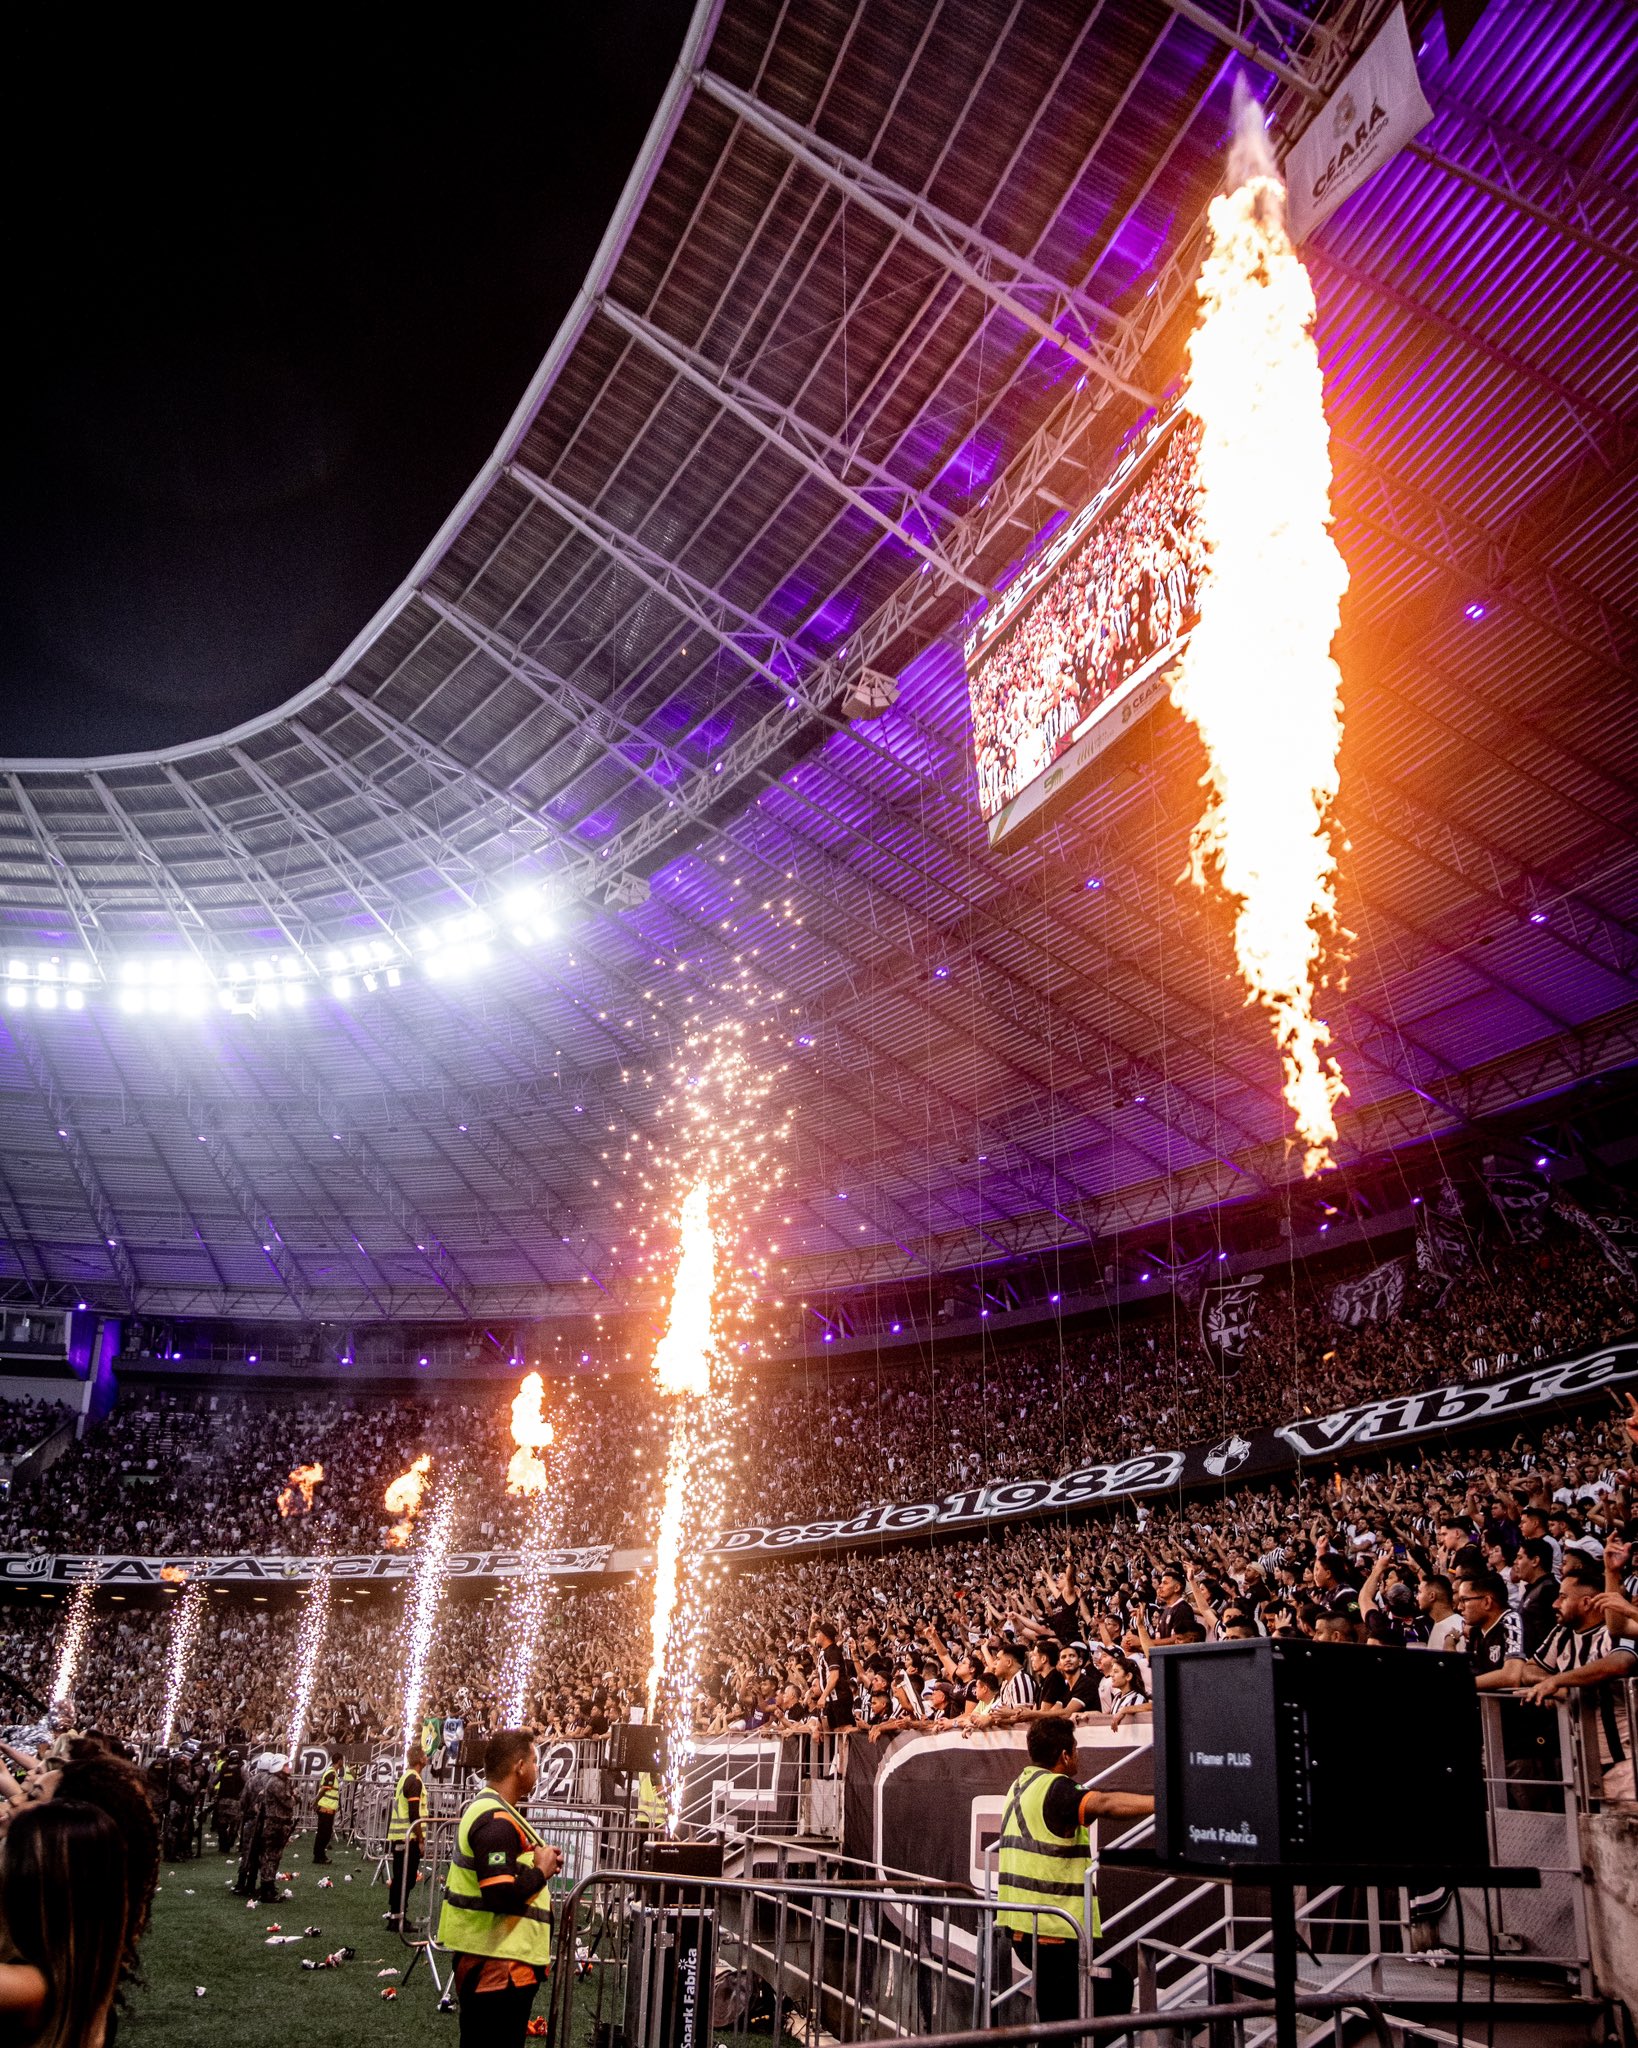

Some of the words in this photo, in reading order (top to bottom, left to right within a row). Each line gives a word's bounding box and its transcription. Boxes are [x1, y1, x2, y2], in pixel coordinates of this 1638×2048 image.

[1312, 97, 1386, 198] CEARÁ
[1275, 1341, 1638, 1456] Vibra
[1226, 1752, 1252, 1767] PLUS
[1189, 1825, 1217, 1842] Spark
